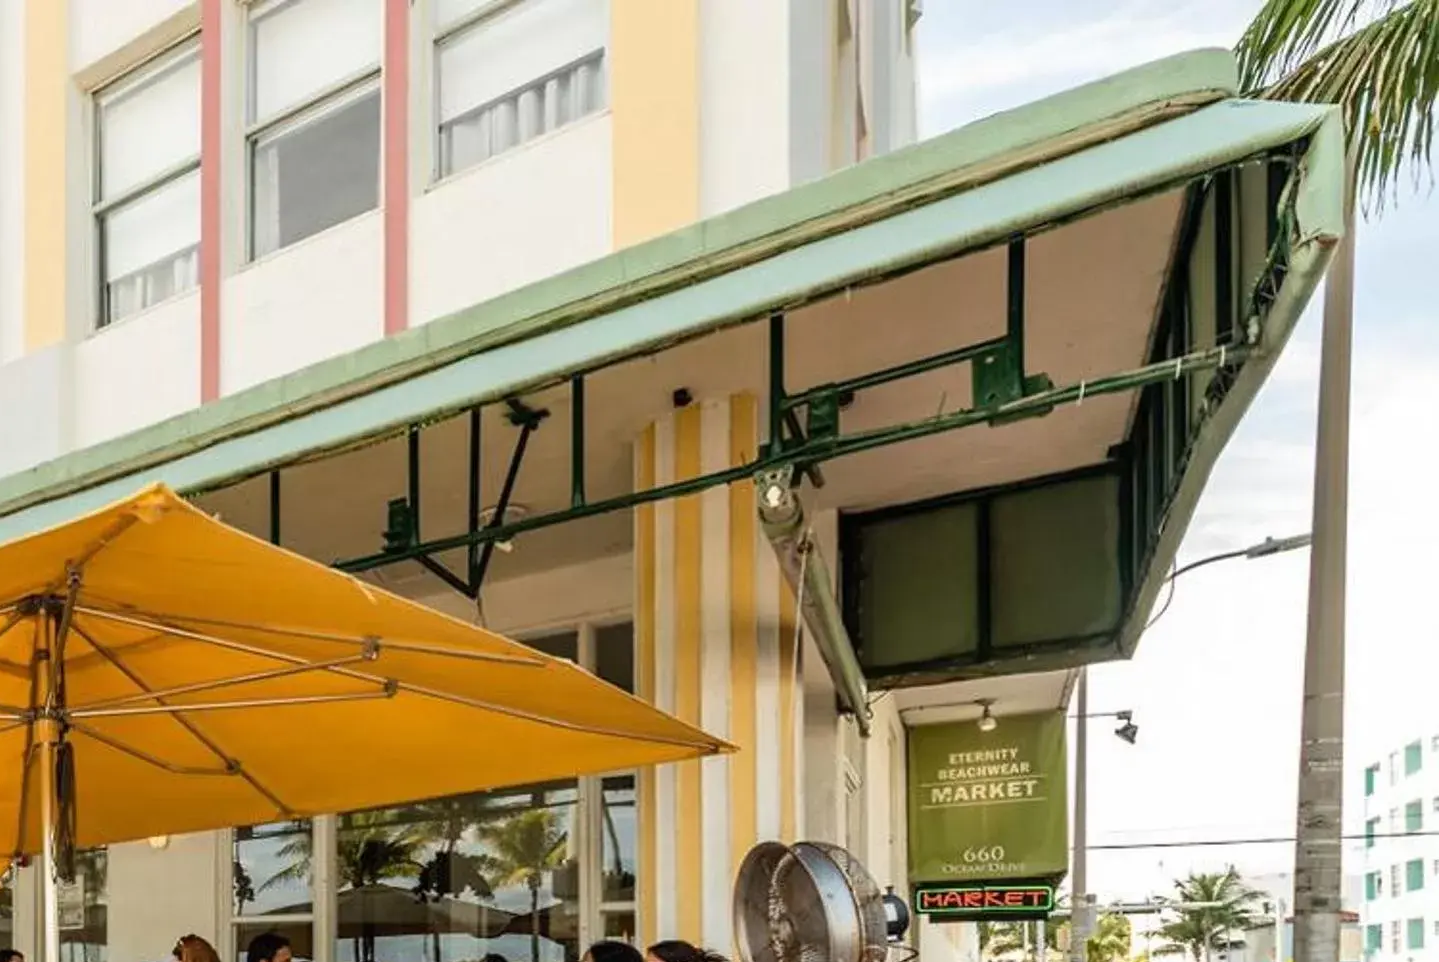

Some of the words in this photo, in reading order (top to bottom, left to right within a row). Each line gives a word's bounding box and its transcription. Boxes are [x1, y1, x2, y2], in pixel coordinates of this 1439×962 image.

[949, 748, 1019, 765] ETERNITY
[938, 762, 1031, 780] BEACHWEAR
[931, 780, 1039, 803] MARKET
[963, 846, 1005, 862] 660
[923, 891, 1047, 908] MARKET
